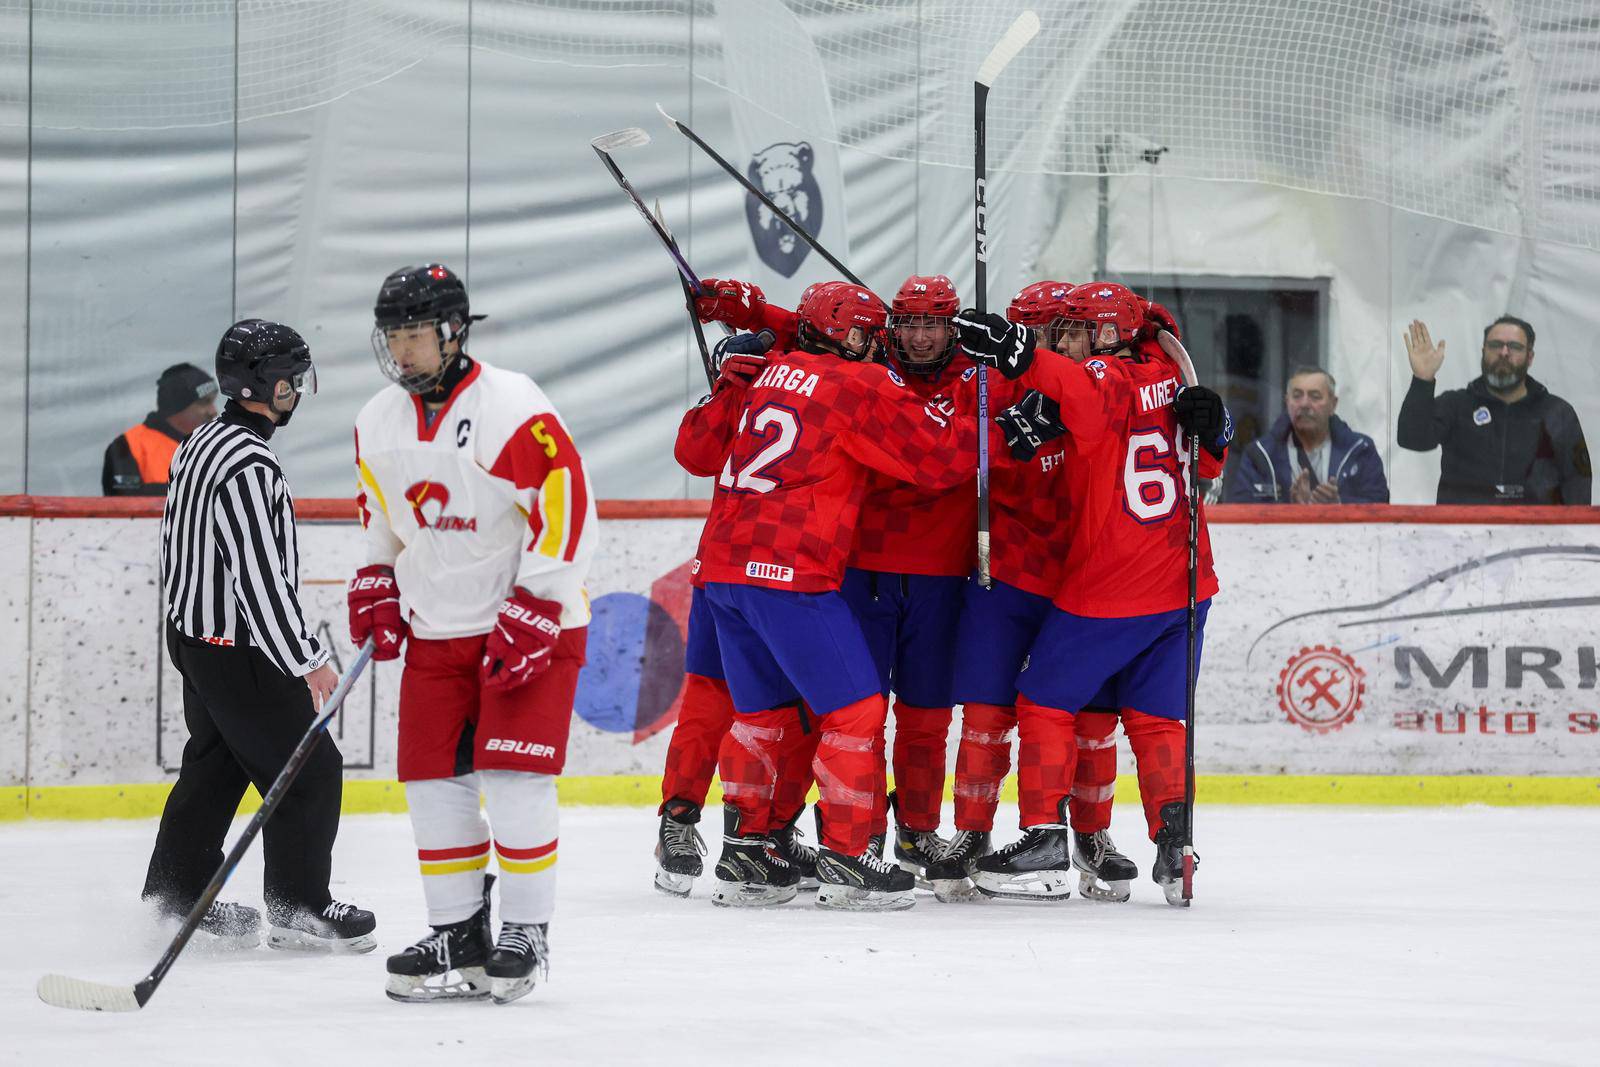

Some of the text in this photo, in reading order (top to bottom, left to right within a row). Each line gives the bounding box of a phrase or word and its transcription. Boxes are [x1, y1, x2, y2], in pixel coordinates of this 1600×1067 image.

[976, 177, 987, 263] CCM
[1097, 311, 1118, 319] CCM
[979, 363, 989, 419] BCOR
[456, 418, 471, 448] C
[530, 420, 558, 459] 5
[757, 564, 790, 580] IIHF
[1393, 706, 1537, 735] auto
[485, 738, 556, 759] BAUER
